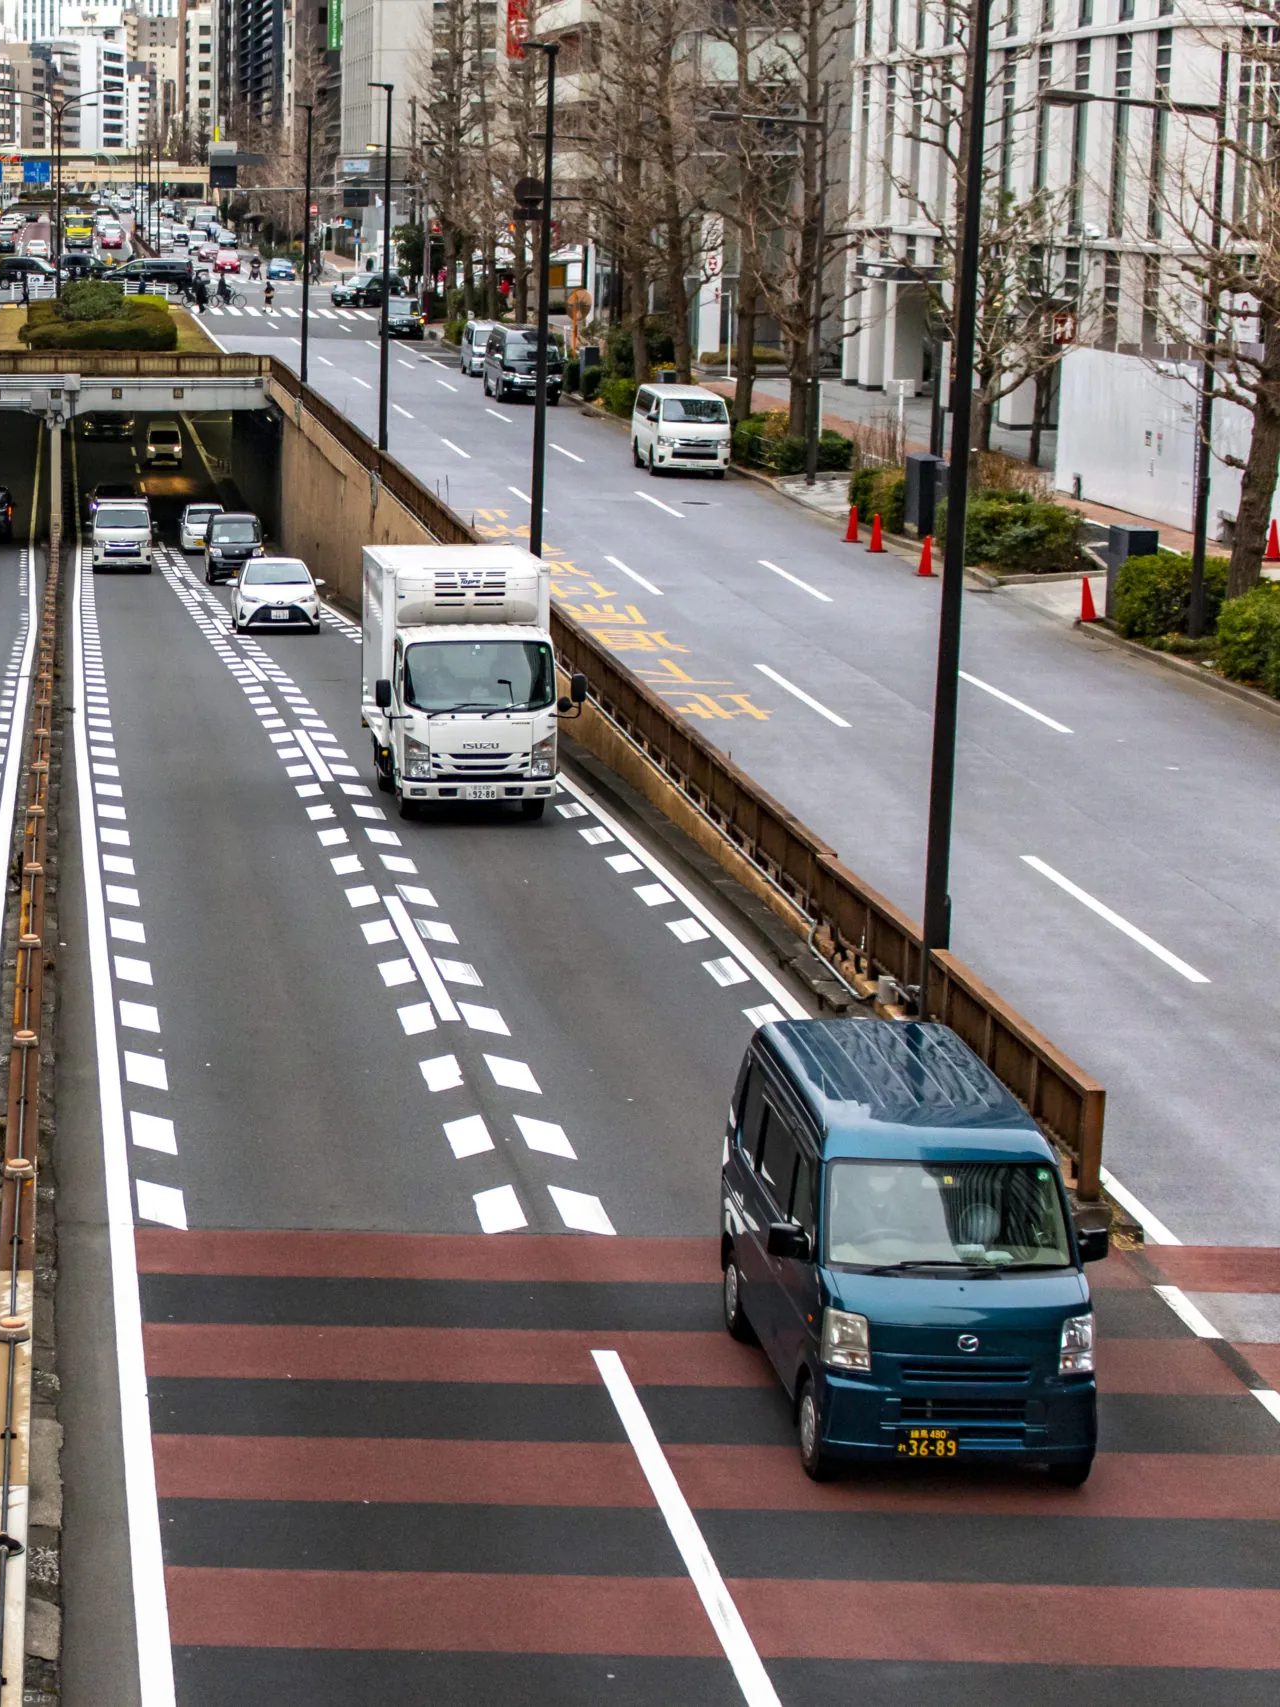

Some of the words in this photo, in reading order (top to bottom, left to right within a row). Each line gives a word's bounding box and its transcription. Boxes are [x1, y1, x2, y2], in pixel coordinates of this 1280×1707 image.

[472, 790, 495, 799] 92-88
[930, 1429, 947, 1439] 480
[908, 1440, 957, 1457] 36-89
